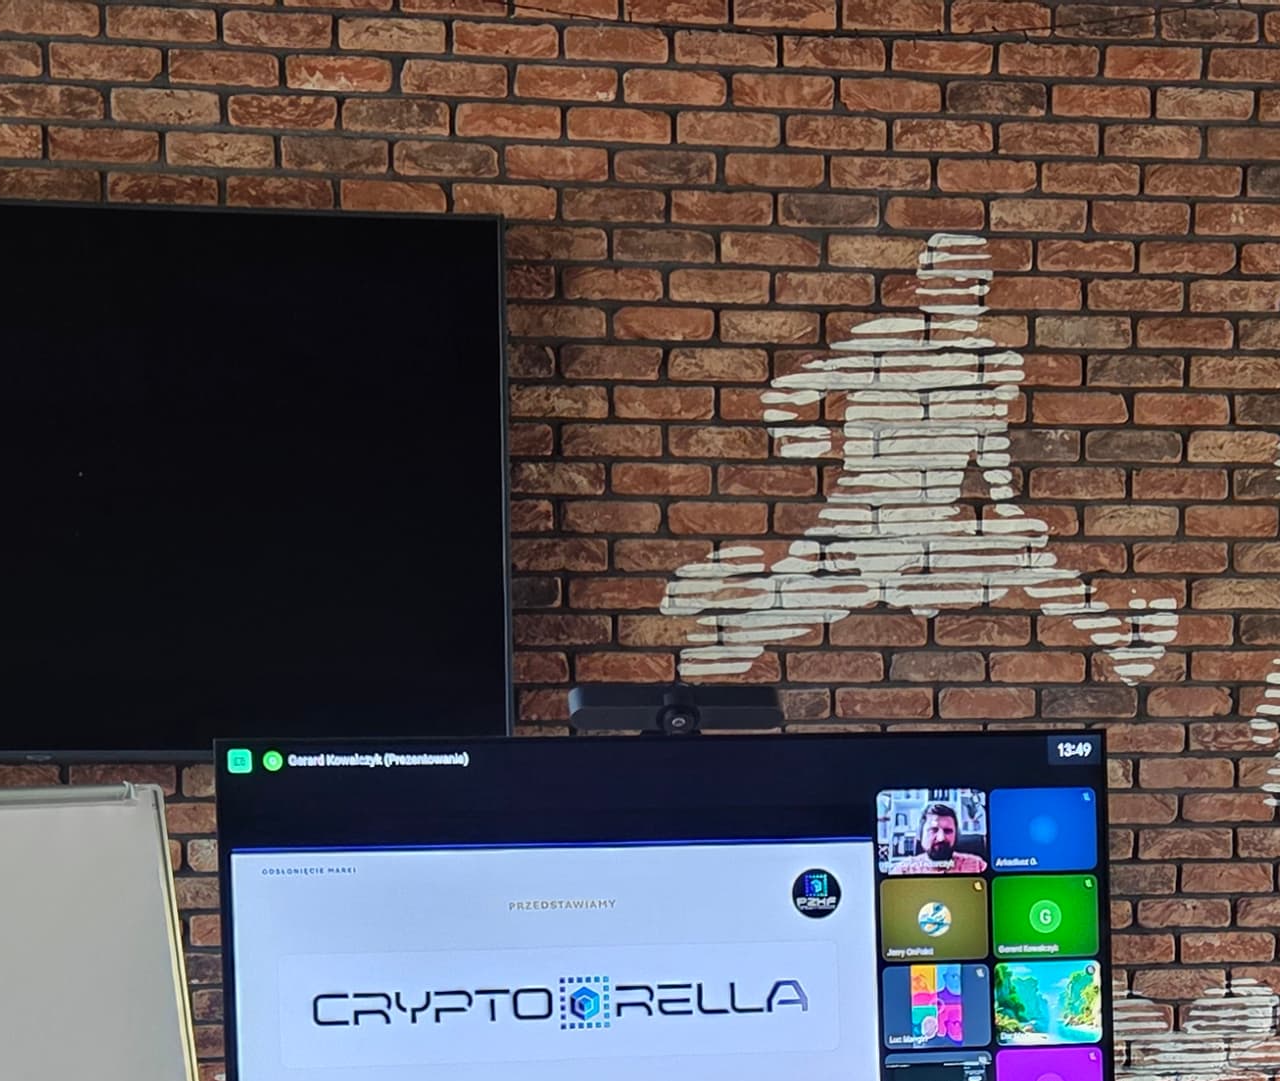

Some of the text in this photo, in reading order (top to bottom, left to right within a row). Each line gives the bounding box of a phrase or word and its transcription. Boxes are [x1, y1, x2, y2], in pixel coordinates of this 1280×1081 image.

[1057, 742, 1092, 757] 13:49
[288, 753, 324, 767] Gerard
[508, 899, 616, 911] PRZEDSTAWIAMY
[1039, 909, 1052, 924] G
